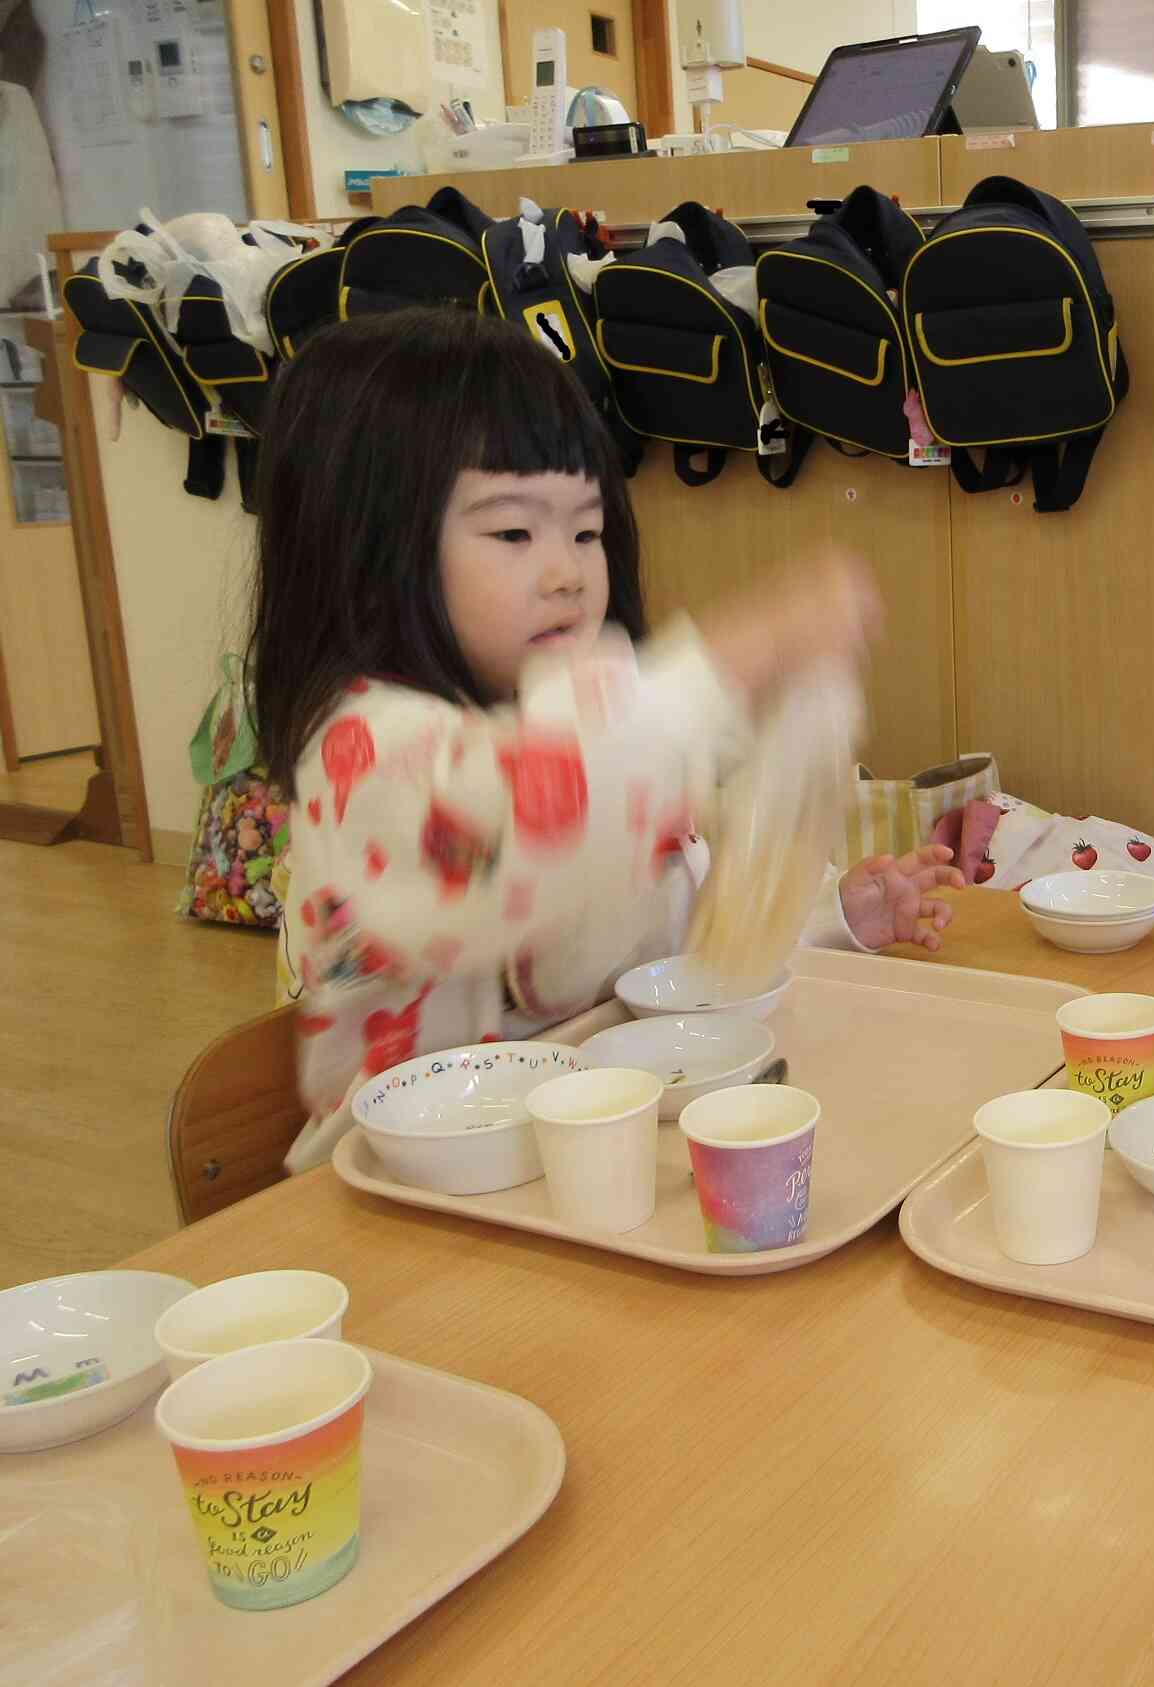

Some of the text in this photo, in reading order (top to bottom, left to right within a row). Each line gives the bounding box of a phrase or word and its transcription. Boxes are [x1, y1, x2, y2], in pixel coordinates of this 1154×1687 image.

[1092, 1068, 1144, 1093] Stay
[223, 1471, 295, 1482] REASON
[192, 1481, 313, 1528] to Stay
